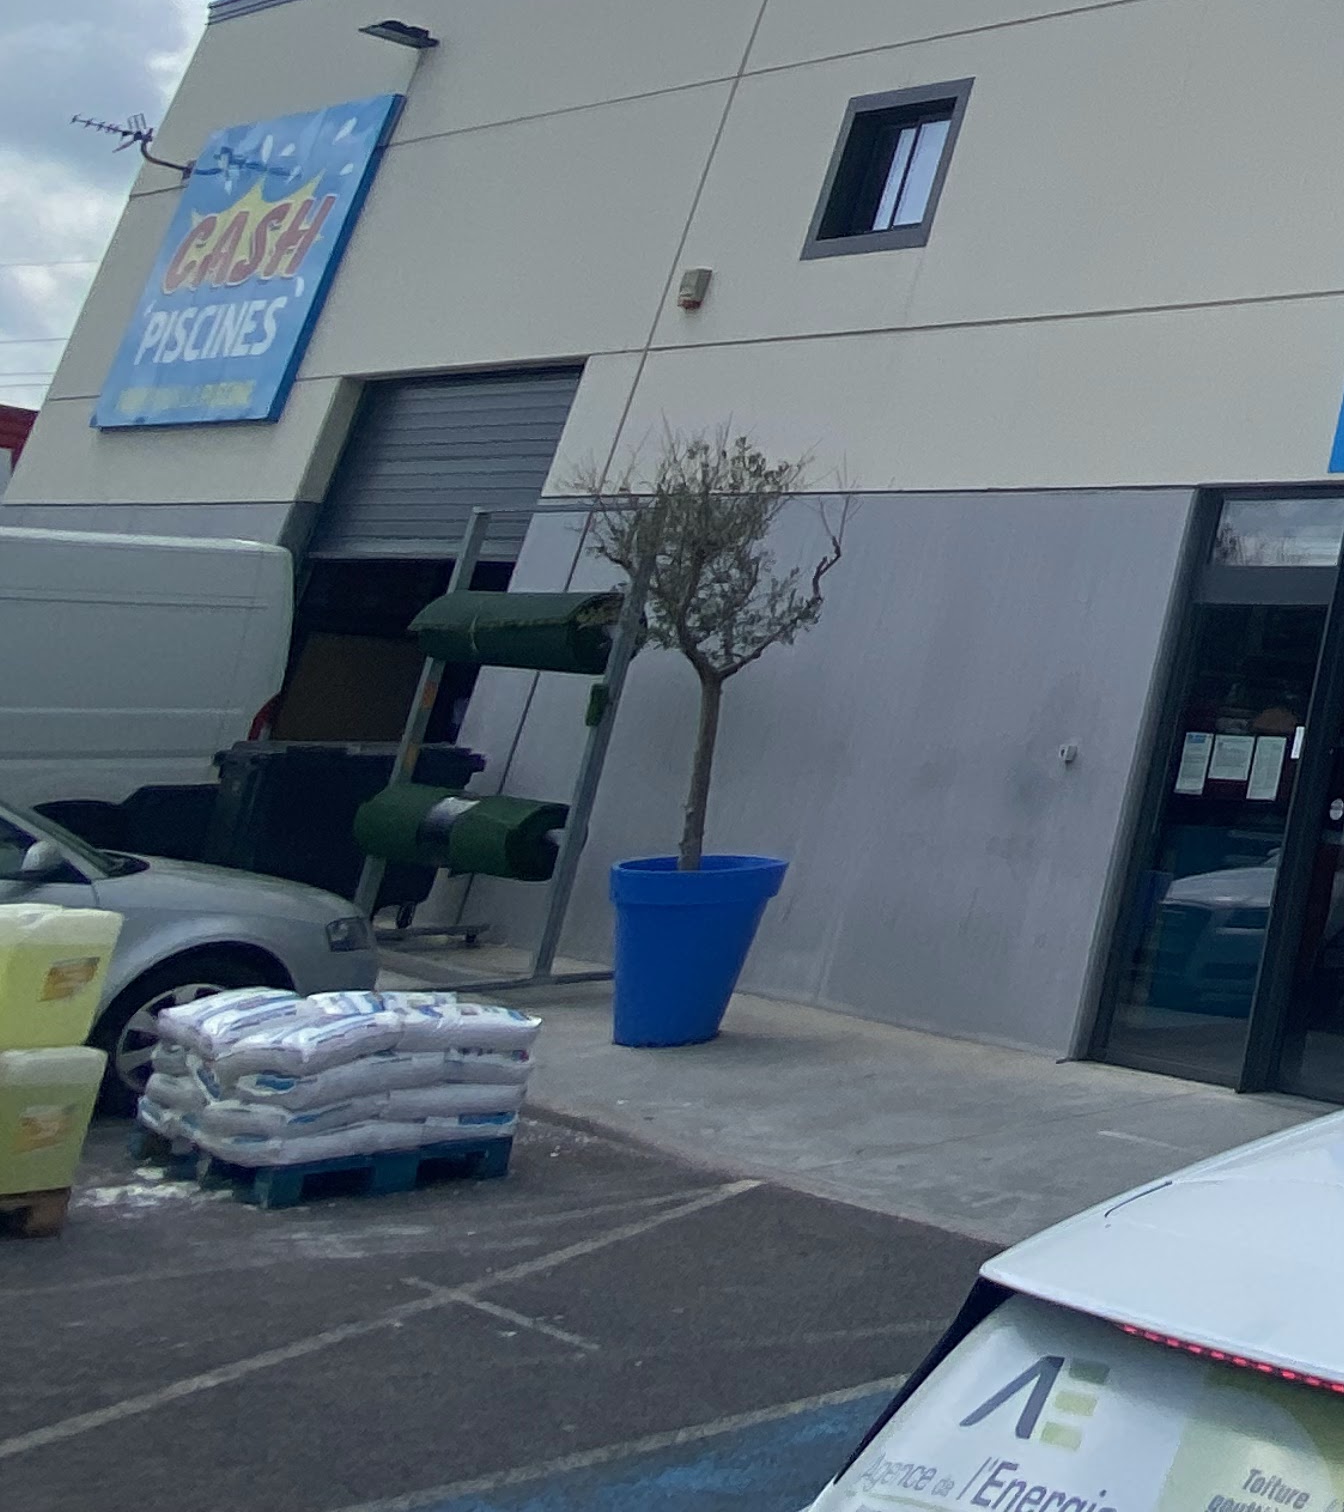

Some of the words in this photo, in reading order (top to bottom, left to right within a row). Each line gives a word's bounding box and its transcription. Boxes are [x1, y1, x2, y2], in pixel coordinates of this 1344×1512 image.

[163, 194, 339, 294] CASH
[134, 296, 288, 366] PISCINES
[861, 1453, 937, 1492] Agence
[956, 1456, 1117, 1512] l'Eneri
[1242, 1468, 1311, 1510] Toiture
